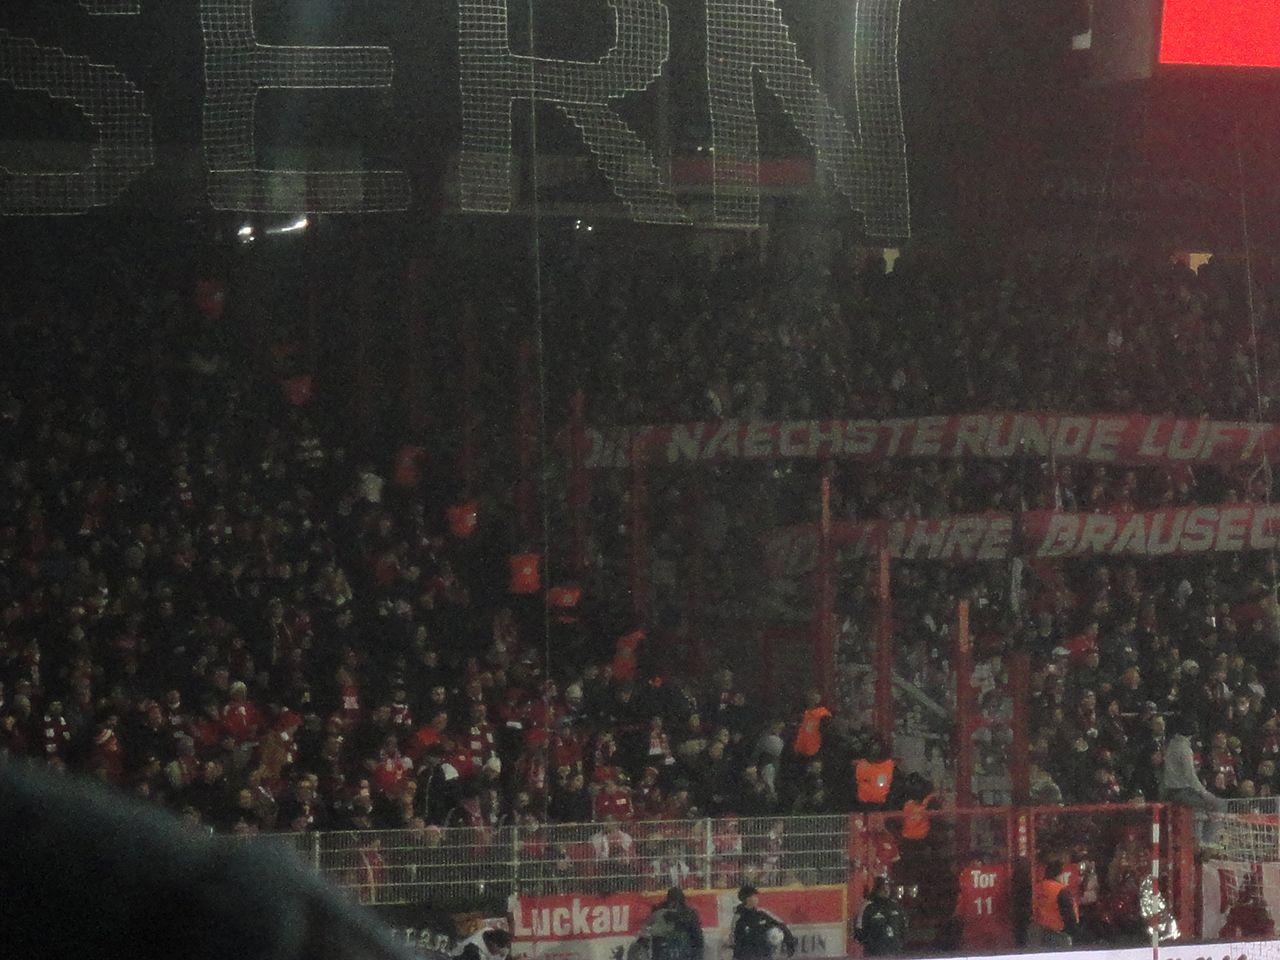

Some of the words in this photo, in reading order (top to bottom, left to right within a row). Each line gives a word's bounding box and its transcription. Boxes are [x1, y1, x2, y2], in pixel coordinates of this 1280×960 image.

[1138, 415, 1275, 460] LUFT
[971, 869, 997, 890] Tor
[508, 895, 630, 937] Luckau
[973, 895, 993, 916] 11
